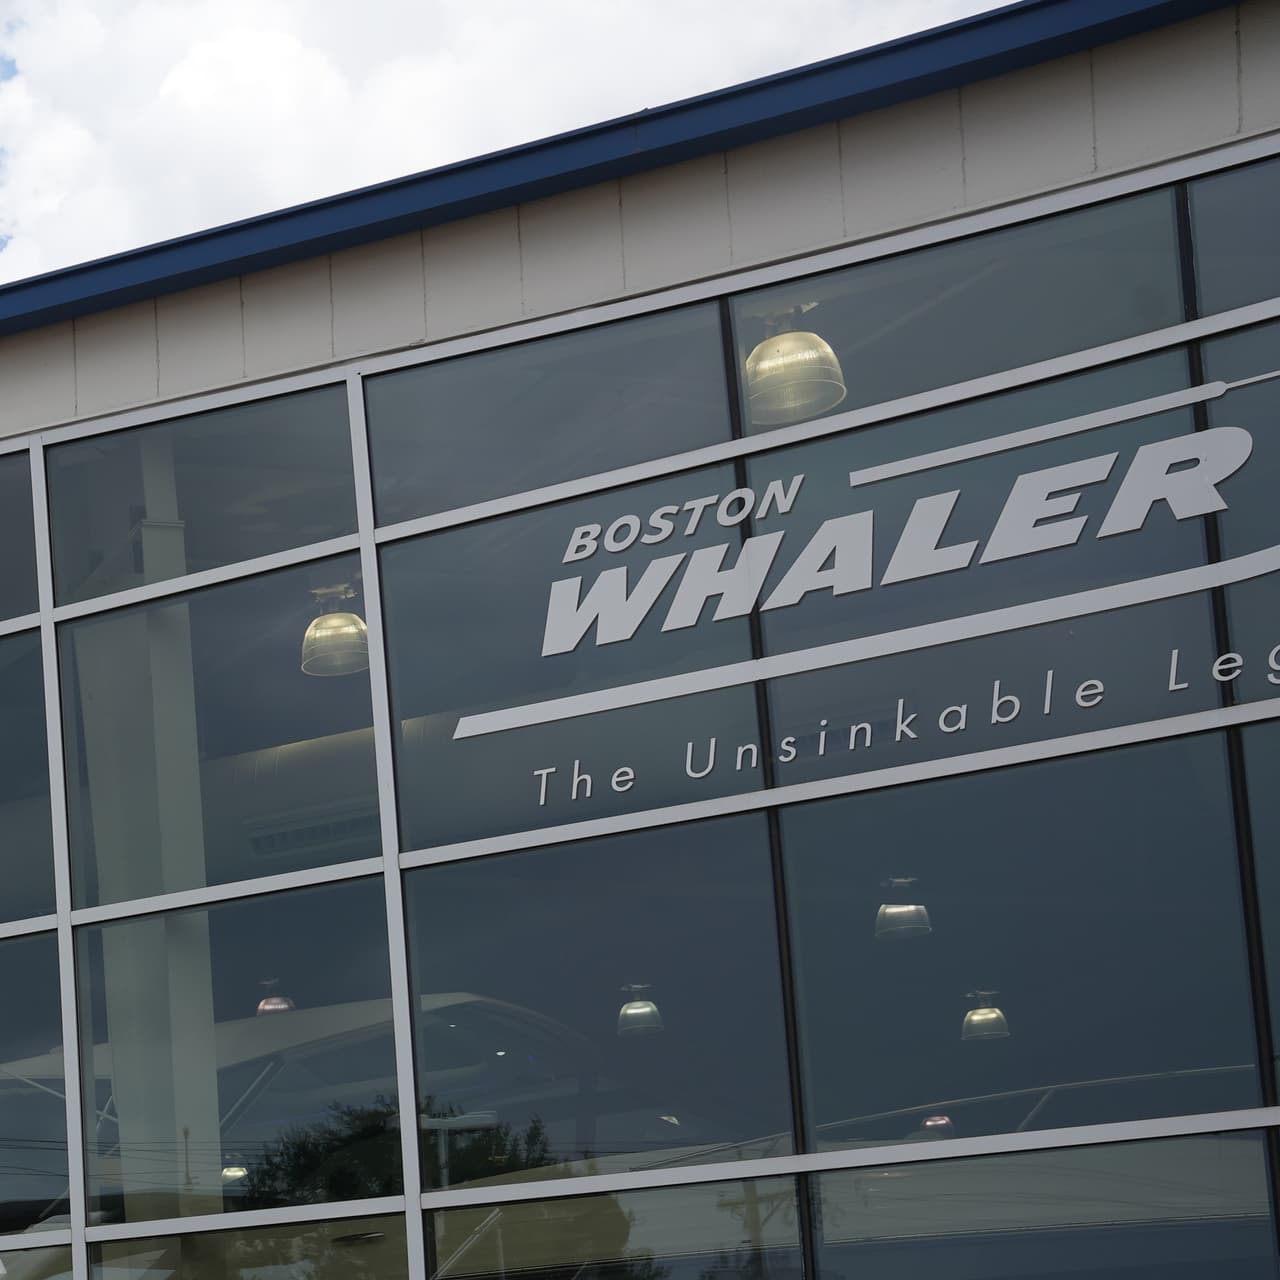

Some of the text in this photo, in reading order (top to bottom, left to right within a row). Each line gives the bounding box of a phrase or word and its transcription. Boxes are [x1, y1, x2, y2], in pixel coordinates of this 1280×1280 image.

[541, 426, 1253, 657] WHALER
[561, 473, 805, 564] BOSTON
[533, 760, 636, 806] The
[684, 670, 1106, 780] Unsinkable
